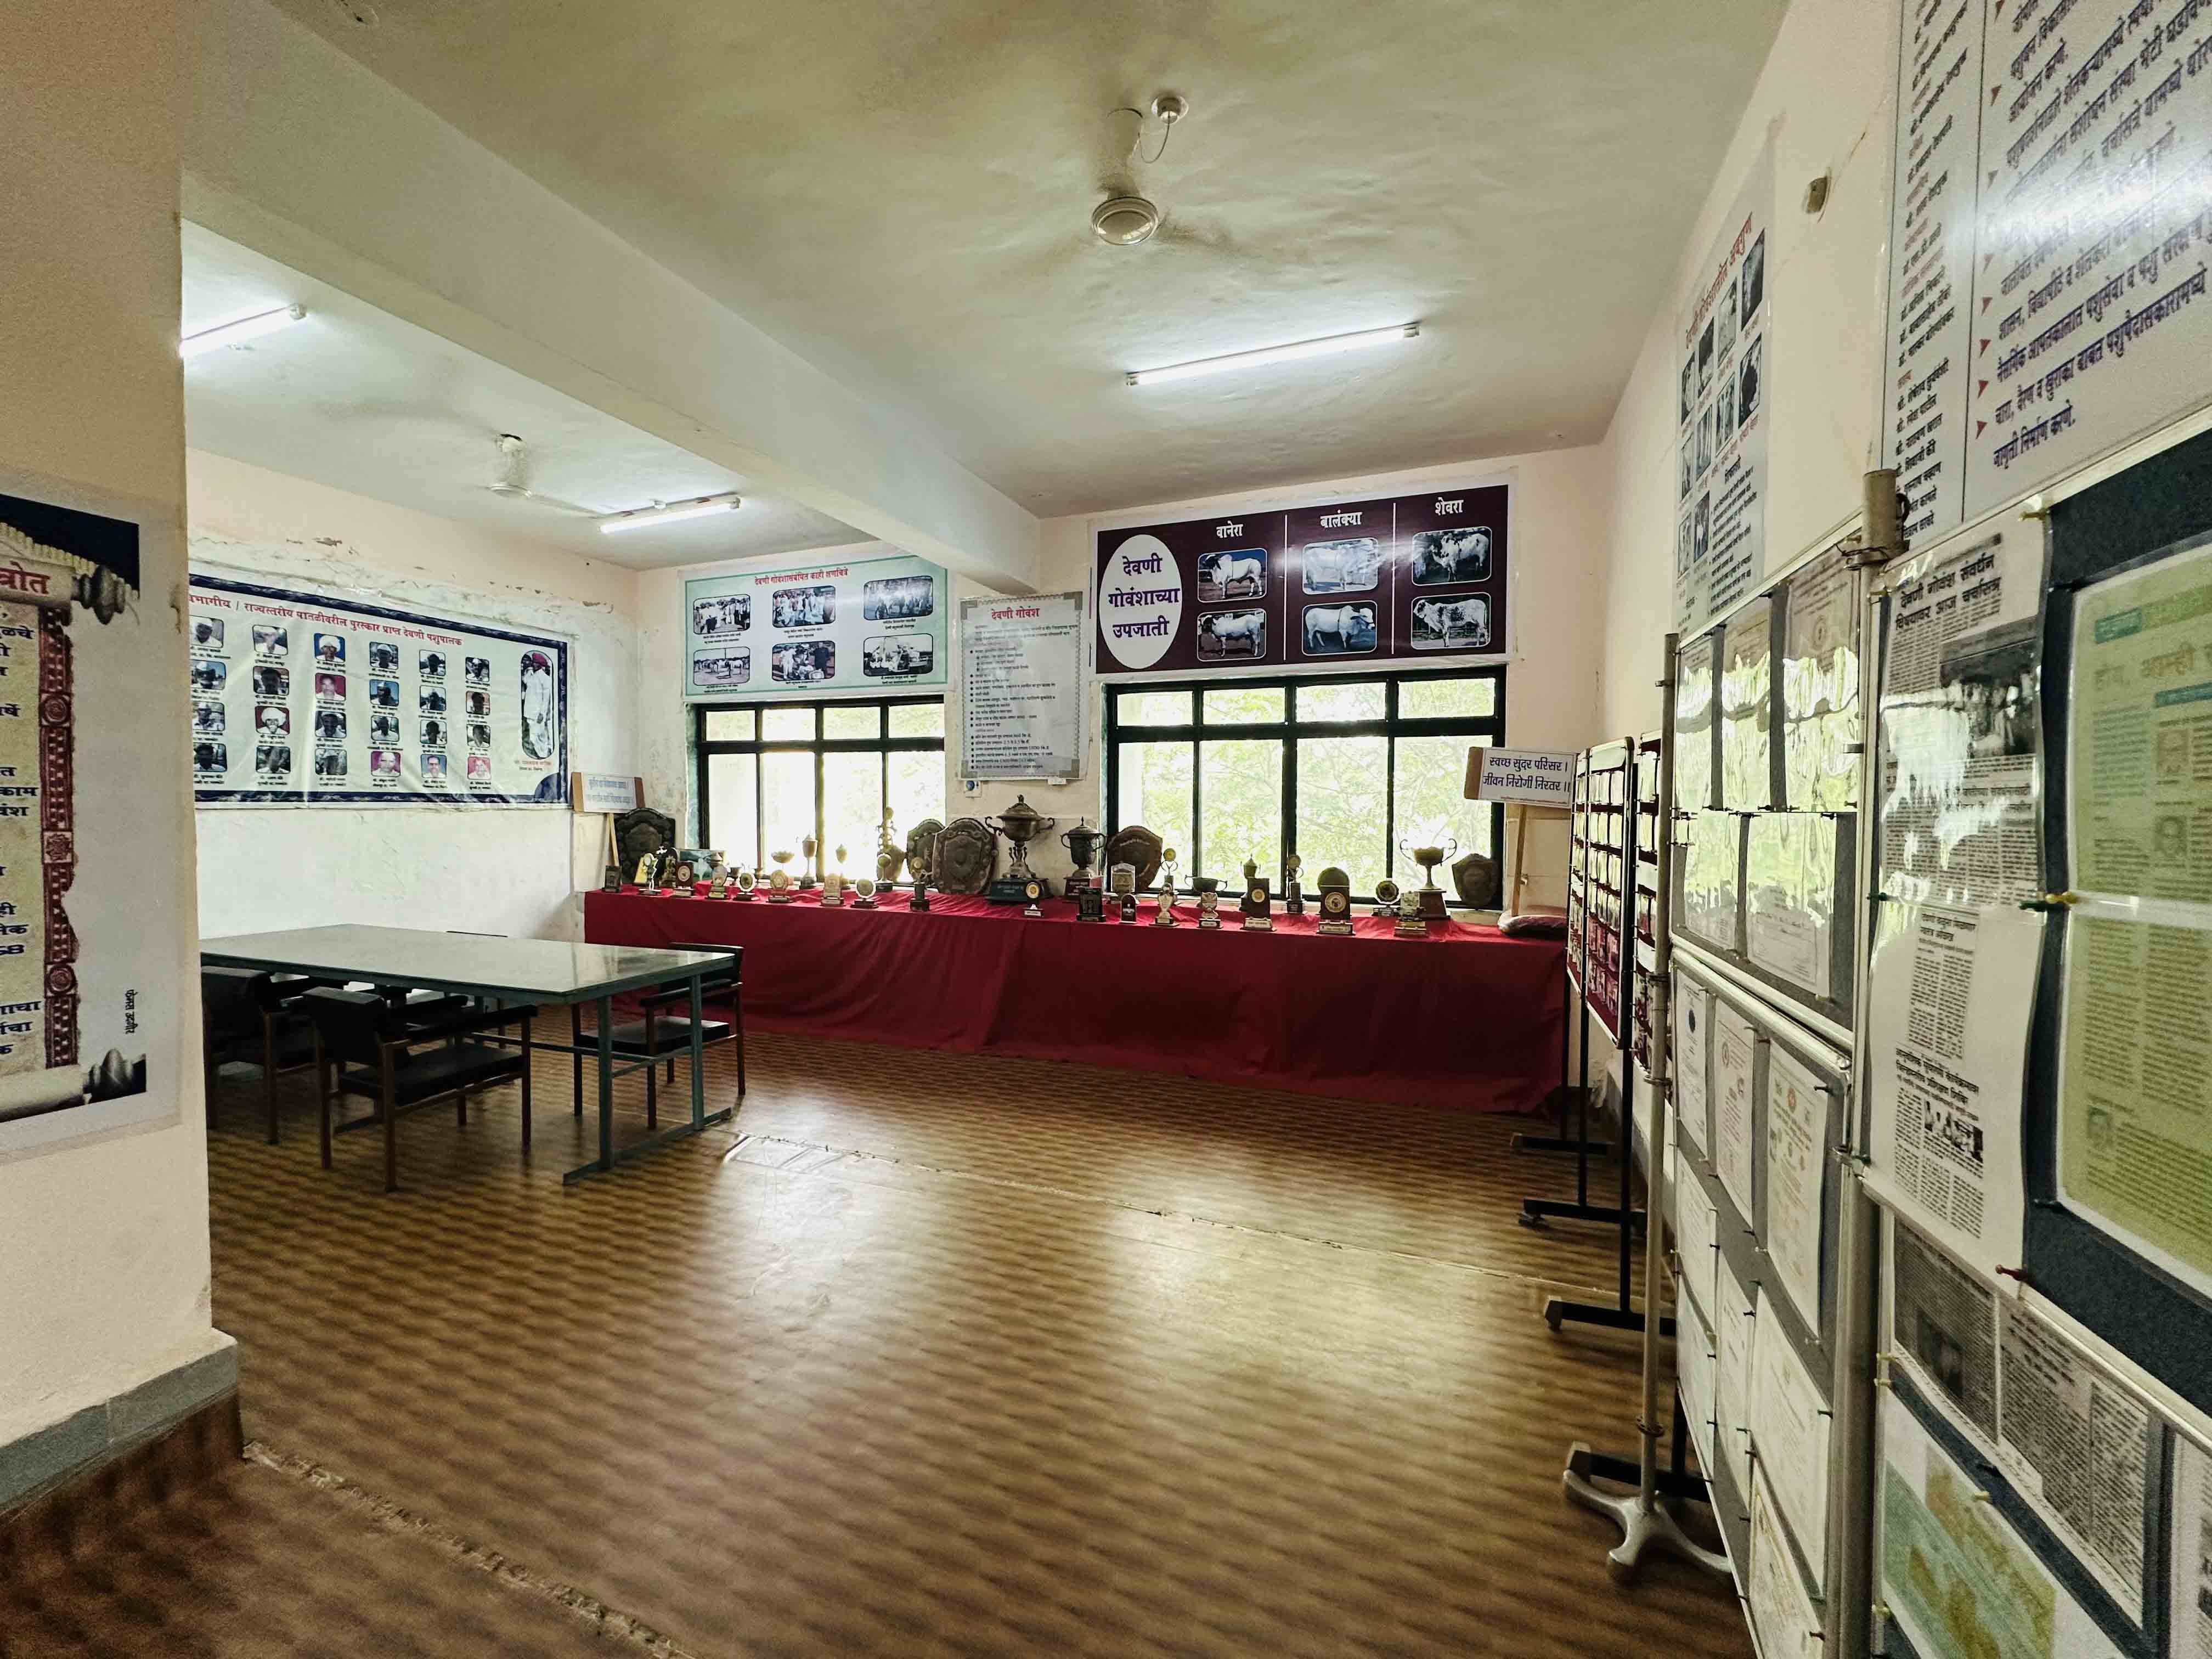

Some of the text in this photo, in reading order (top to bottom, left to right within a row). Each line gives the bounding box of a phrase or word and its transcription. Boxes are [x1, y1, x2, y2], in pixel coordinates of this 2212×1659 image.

[1435, 496, 1464, 516] शेवरा
[1320, 510, 1362, 529] बालंक्या
[1216, 523, 1244, 539] वानेरा
[1122, 551, 1163, 577] देवणी
[754, 575, 769, 586] देवणी
[810, 569, 825, 579] काही
[1900, 552, 1995, 609] देवणी गोवंश संवर्धन
[1108, 585, 1180, 607] गोवंशाच्या
[1895, 577, 2002, 631] विषयावर आज चर्चासत्र
[991, 605, 1041, 620] देवणी गोवंश
[351, 620, 380, 631] पुरस्कार
[382, 624, 401, 636] प्राप्त
[404, 626, 425, 641] देवणी
[427, 632, 463, 646] पशुपालक
[1112, 614, 1170, 639] उपजाती
[1489, 757, 1511, 768] स्वच्छ
[1534, 757, 1563, 771] परिसर
[1483, 772, 1505, 787] जीवन
[1506, 774, 1533, 789] निरोगी
